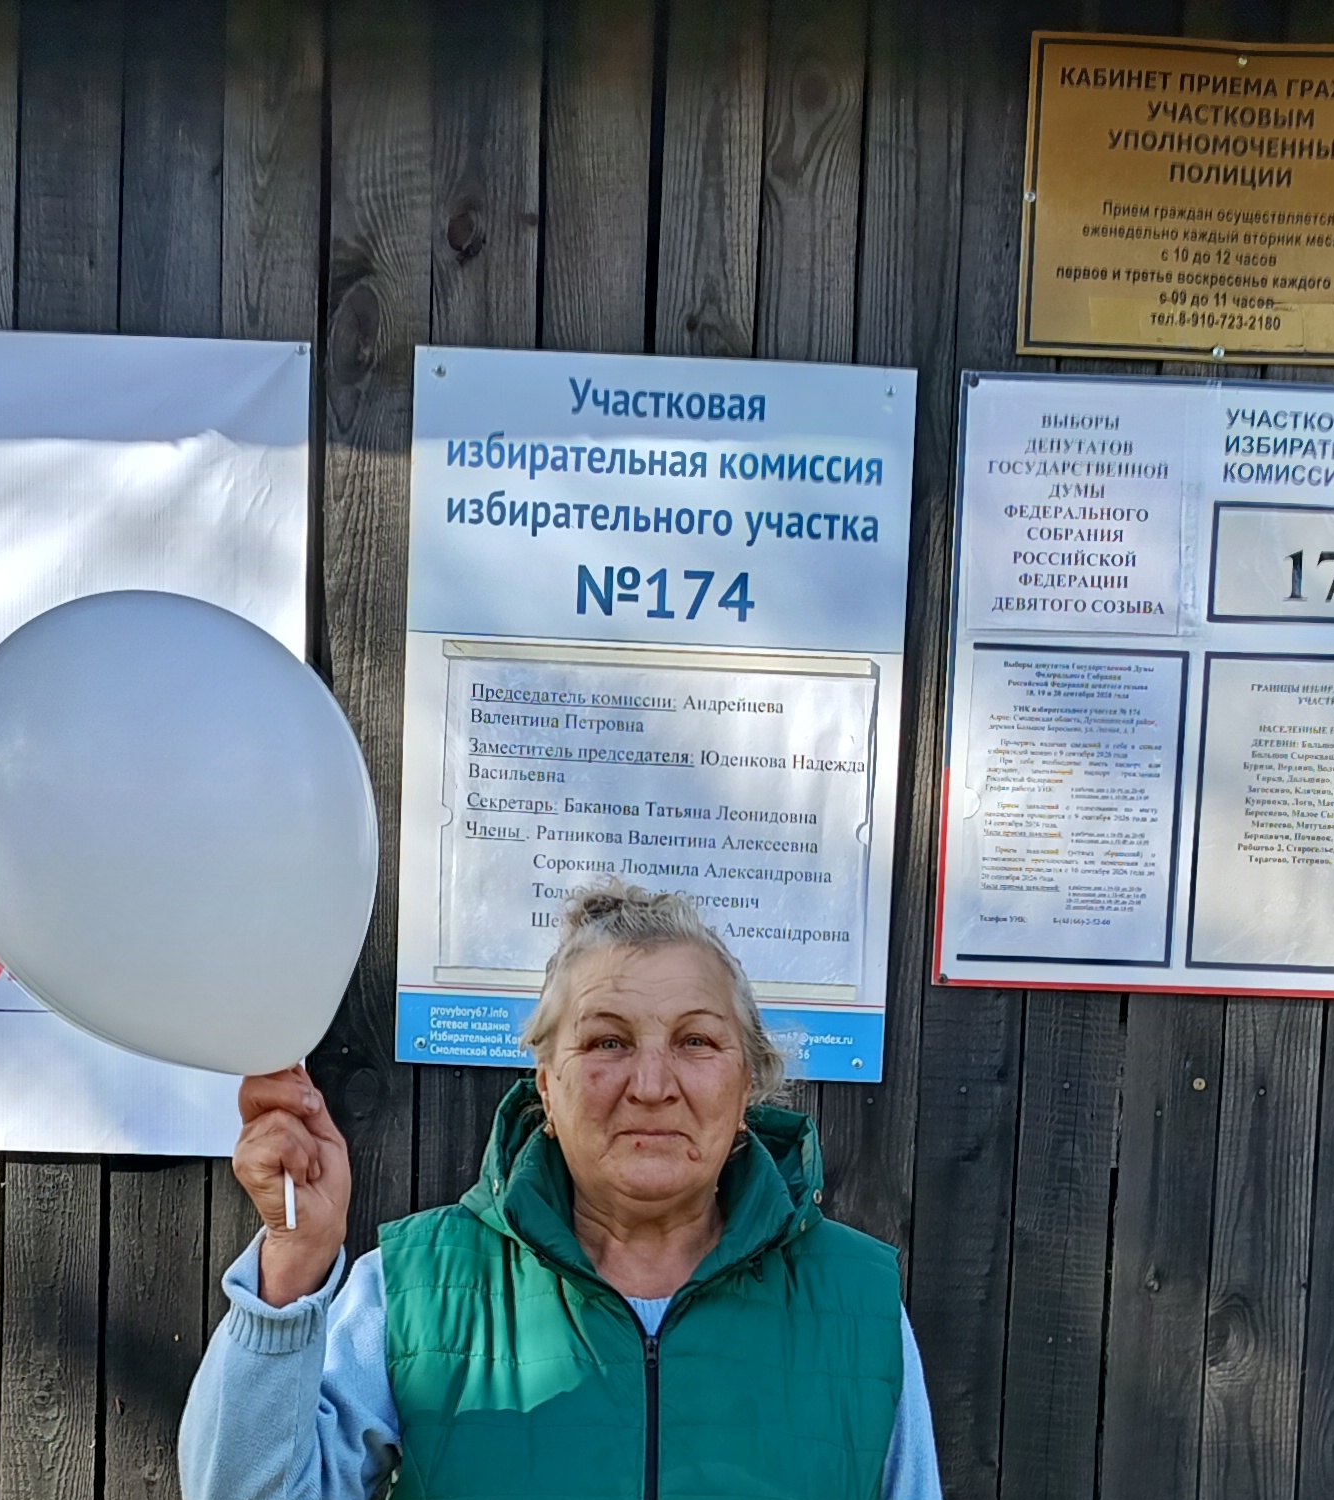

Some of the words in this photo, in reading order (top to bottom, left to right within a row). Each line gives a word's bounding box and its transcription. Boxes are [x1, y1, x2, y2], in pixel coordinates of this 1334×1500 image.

[1060, 66, 1170, 91] КАБИНЕТ
[1180, 73, 1277, 97] ПРИЕМА
[1147, 101, 1314, 129] УЧАСТКОВЫМ
[1170, 162, 1292, 189] ПОЛИЦИИ
[1155, 206, 1212, 224] граждан
[1082, 224, 1178, 242] еженедельно
[1183, 226, 1239, 246] каждый
[1243, 232, 1301, 250] вторник
[1161, 250, 1168, 261] с
[1173, 247, 1189, 262] 10
[1193, 250, 1210, 265] до
[1216, 249, 1231, 264] 12
[1236, 252, 1276, 266] часов
[1056, 265, 1107, 282] первое
[1112, 269, 1121, 280] и
[1125, 269, 1172, 286] третье
[1177, 272, 1267, 290] воскресенье
[1272, 276, 1330, 292] каждого
[1159, 294, 1166, 305] с
[1171, 291, 1187, 306] 09
[1191, 293, 1208, 309] до
[1214, 293, 1228, 307] 11
[1232, 296, 1274, 310] часов
[569, 376, 766, 422] Участковая
[1041, 413, 1120, 431] ВЫБОРЫ
[1025, 437, 1133, 457] ДЕПУТАТОВ
[447, 431, 707, 479] избирательная
[719, 451, 884, 486] комиссия
[988, 459, 1169, 480] ГОСУДАРСТВЕННОЙ
[1048, 482, 1105, 500] ДУМЫ
[447, 490, 733, 536] избирательного
[745, 509, 879, 546] участка
[1004, 504, 1149, 523] ФЕДЕРАЛЬНОГО
[1027, 526, 1124, 543] СОБРАНИЯ
[1012, 549, 1137, 568] РОССИЙСКОЙ
[1019, 572, 1129, 591] ФЕДЕРАЦИИ
[576, 564, 755, 622] №174
[991, 596, 1086, 615] ДЕВЯТОГО
[1091, 598, 1165, 616] СОЗЫВА
[1251, 683, 1300, 694] ГРАНИЦЫ
[471, 683, 587, 706] Председатель
[591, 691, 677, 712] комиссии:
[683, 694, 784, 716] Андрейцева
[471, 708, 559, 730] Валентина
[565, 713, 644, 735] Петровна
[468, 737, 573, 759] Заместитель
[578, 745, 695, 767] председателя:
[700, 749, 786, 771] Юденкова
[792, 753, 865, 776] Надежда
[468, 763, 565, 784] Васильевна
[467, 791, 558, 815] Секретарь:
[564, 797, 640, 818] Баканова
[645, 801, 711, 821] Татьяна
[716, 805, 817, 827] Леонидовна
[536, 825, 623, 846] Ратникова
[628, 829, 716, 850] Валентина
[722, 833, 818, 854] Алексеевна
[533, 853, 615, 876] Сорокина
[620, 857, 699, 880] Людмила
[704, 861, 832, 885] Александровна
[674, 889, 759, 910] Сергеевич
[724, 922, 850, 943] Александровна
[430, 1005, 508, 1019] provybory67.info
[430, 1018, 468, 1030] Сетевое
[471, 1022, 511, 1032] издание
[430, 1031, 502, 1044] Избирательной
[430, 1044, 487, 1057] Смоленской
[490, 1045, 527, 1058] области
